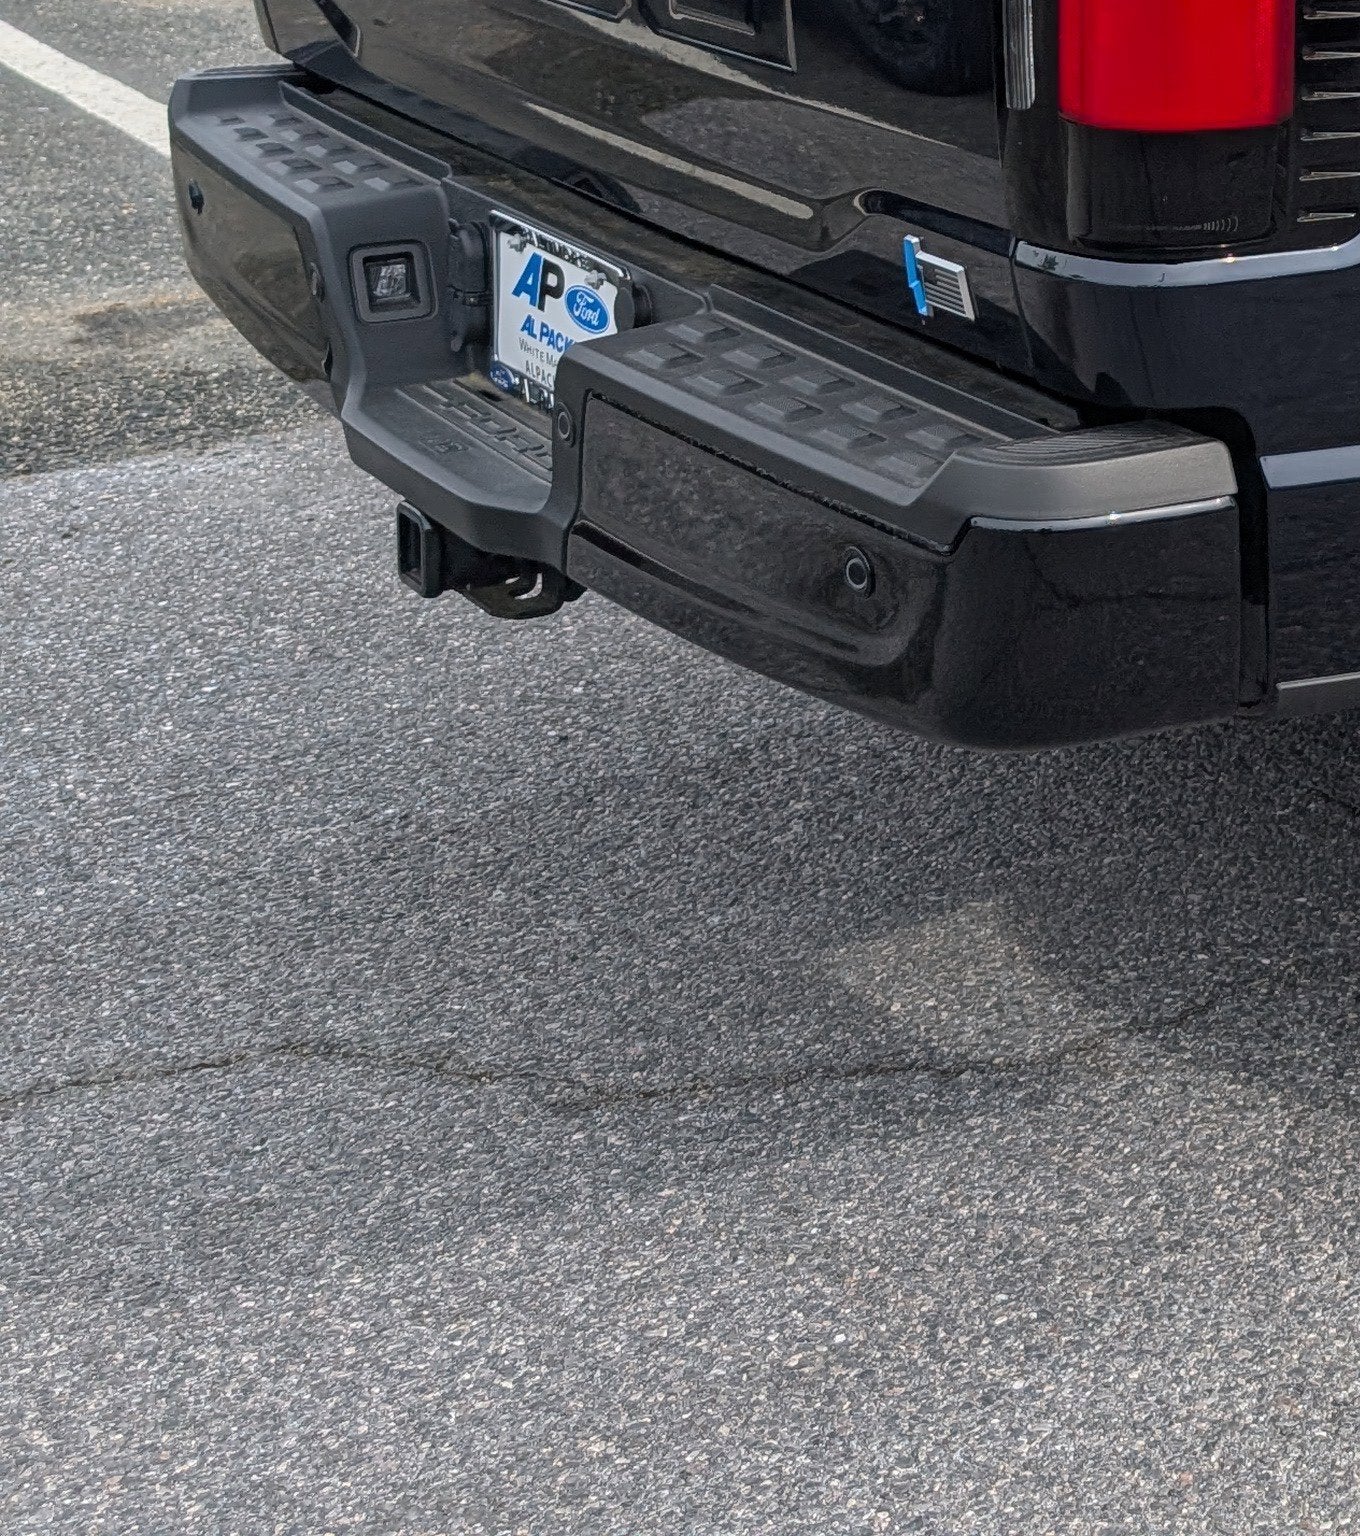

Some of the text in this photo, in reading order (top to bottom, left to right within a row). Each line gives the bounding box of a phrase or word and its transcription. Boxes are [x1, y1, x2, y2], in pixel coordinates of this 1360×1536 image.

[512, 252, 565, 312] AP
[573, 291, 600, 327] Ford
[539, 321, 576, 353] PACK
